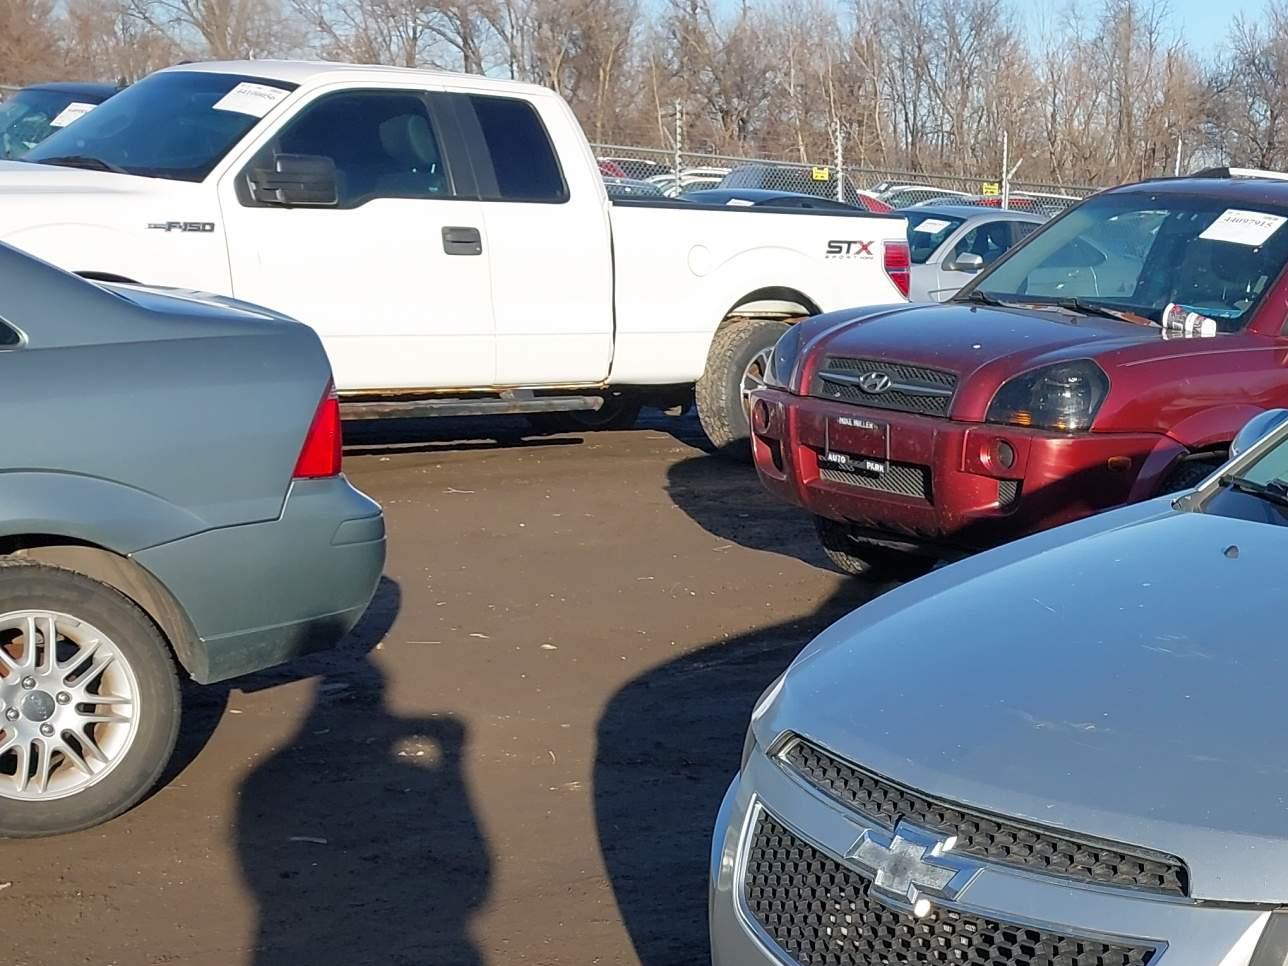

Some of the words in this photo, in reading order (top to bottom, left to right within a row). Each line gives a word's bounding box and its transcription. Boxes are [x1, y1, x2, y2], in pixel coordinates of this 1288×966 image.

[826, 240, 875, 255] STX
[828, 453, 846, 464] AUTO
[866, 461, 885, 473] PARK
